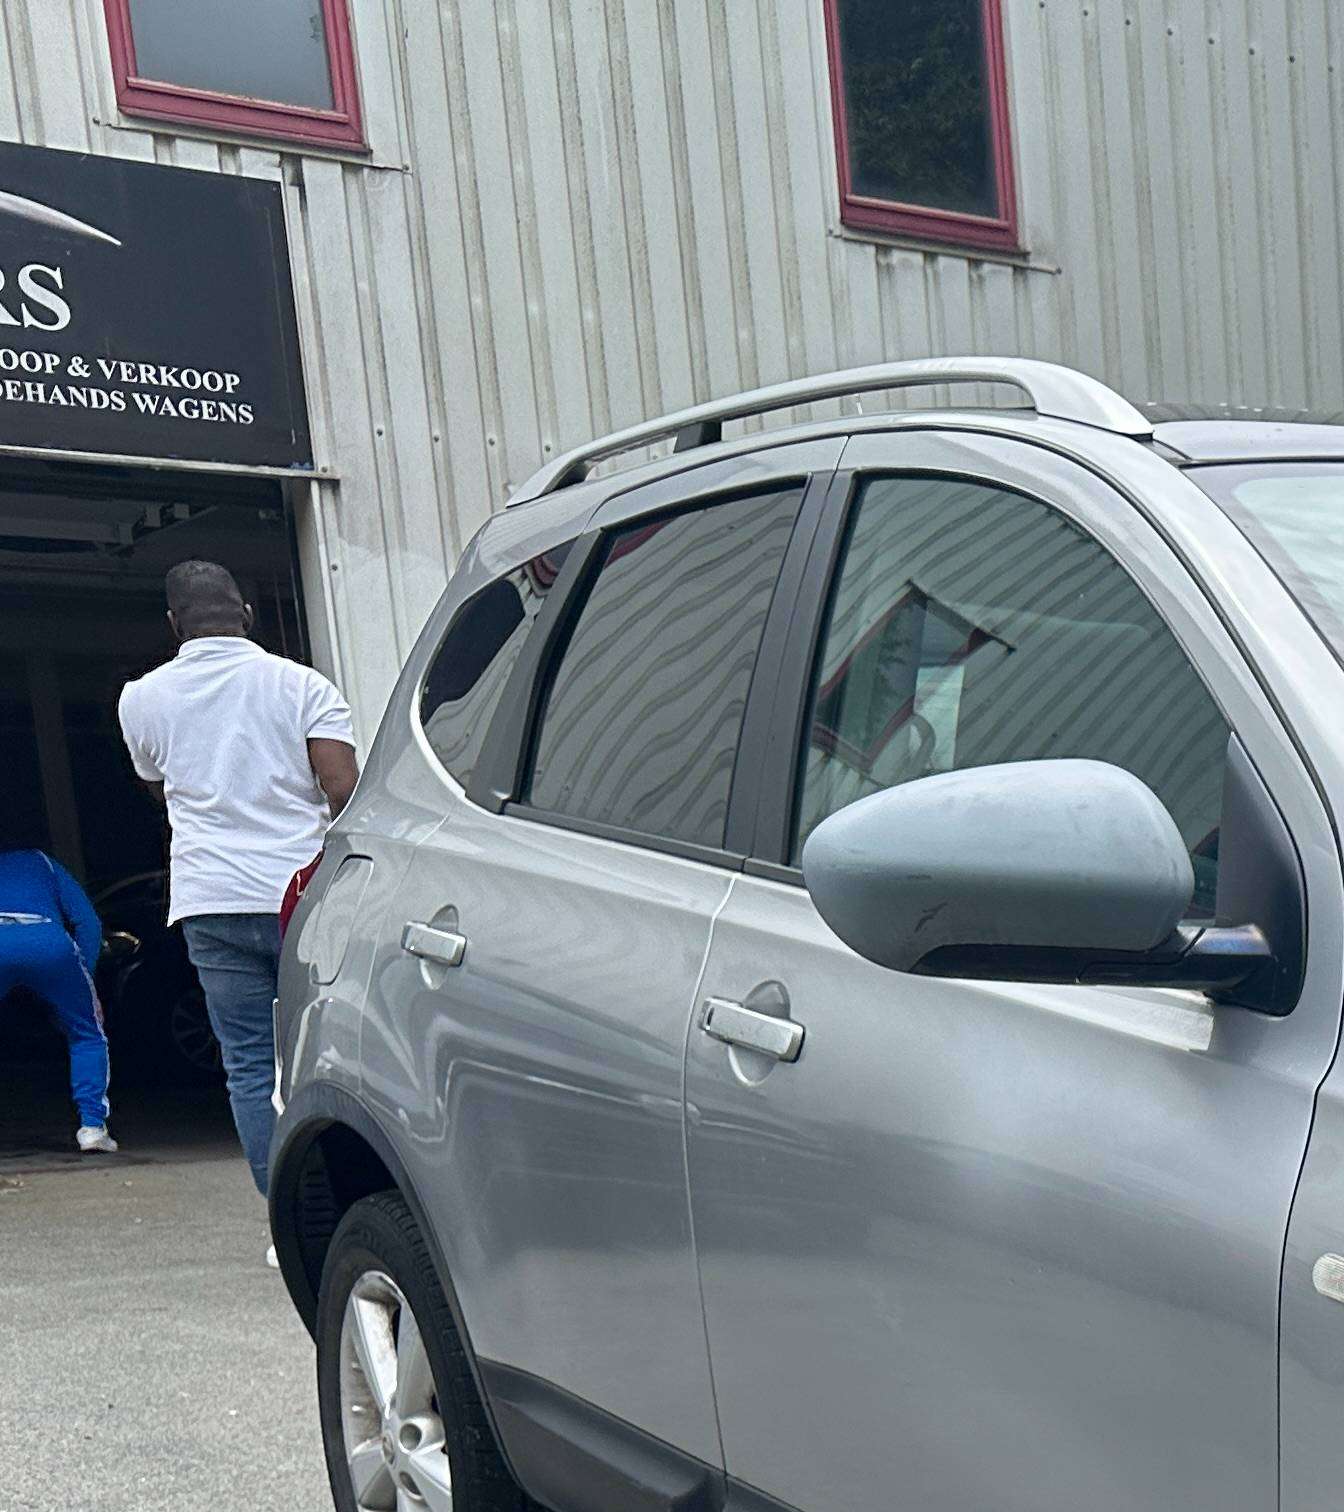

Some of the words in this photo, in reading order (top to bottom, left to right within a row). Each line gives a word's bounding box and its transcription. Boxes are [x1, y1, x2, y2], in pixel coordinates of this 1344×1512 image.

[67, 355, 92, 378] &
[97, 358, 241, 393] VERKOOP
[0, 379, 127, 412] EHANDS
[131, 392, 254, 425] WAGENS
